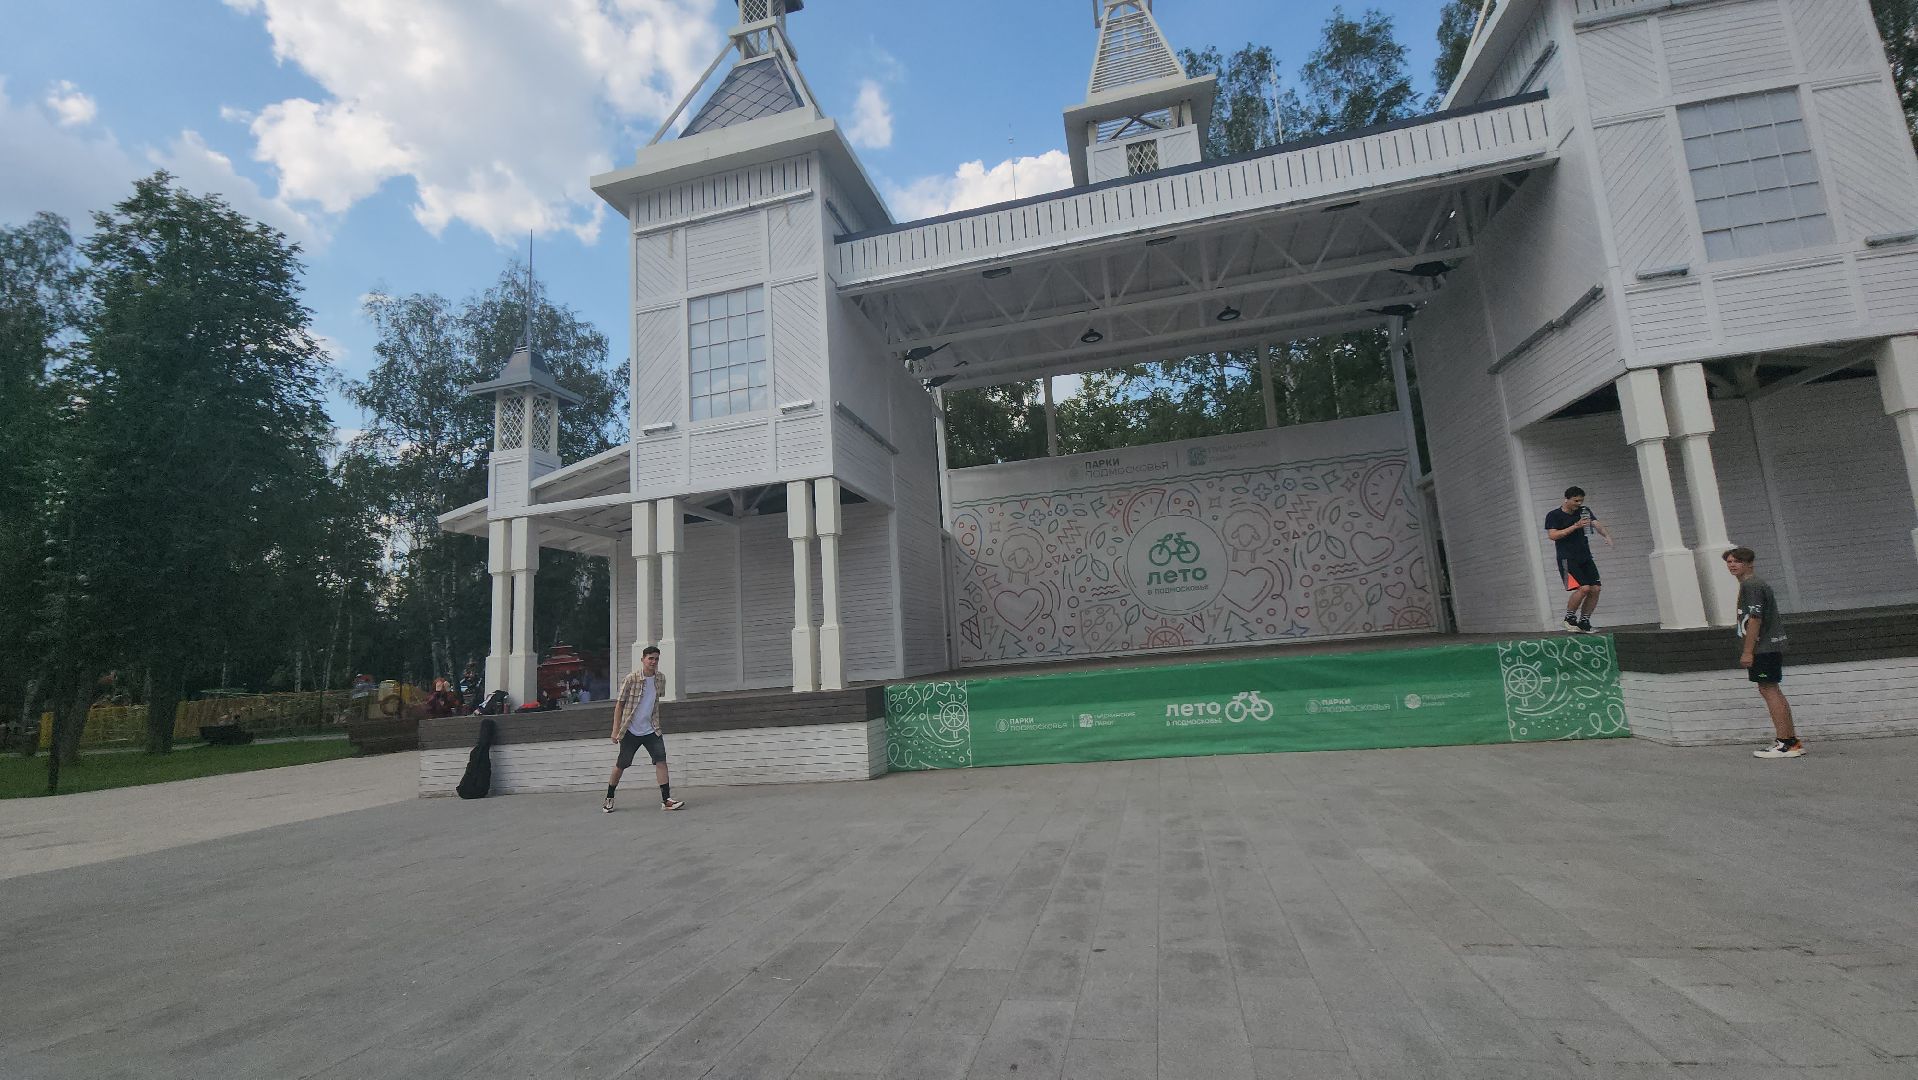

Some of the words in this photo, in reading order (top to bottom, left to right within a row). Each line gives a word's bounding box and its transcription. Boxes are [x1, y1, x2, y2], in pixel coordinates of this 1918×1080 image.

[1085, 457, 1120, 470] ПАРКИ
[1086, 461, 1169, 479] ПОДМОСКОВЬЯ
[1147, 567, 1207, 585] лето
[1321, 697, 1351, 705] ПАРКИ
[1165, 701, 1221, 717] лето
[1320, 703, 1391, 713] ПОДМОСКОВЬЯ
[1009, 717, 1034, 725] ПАРКИ
